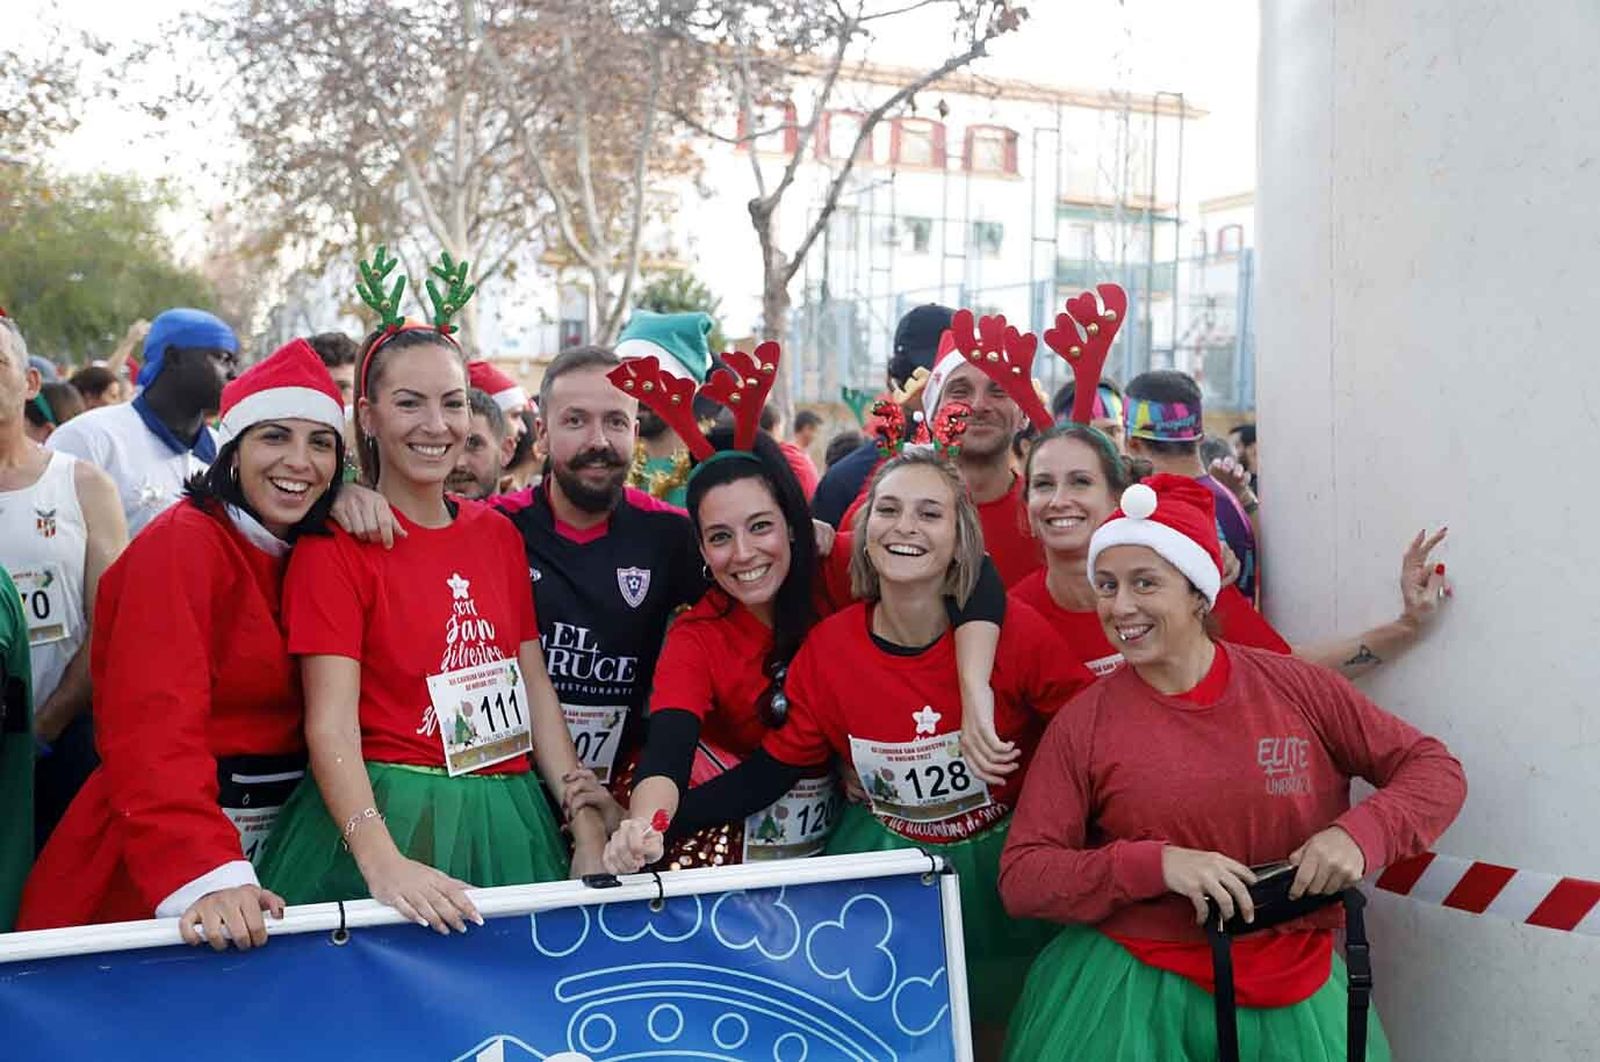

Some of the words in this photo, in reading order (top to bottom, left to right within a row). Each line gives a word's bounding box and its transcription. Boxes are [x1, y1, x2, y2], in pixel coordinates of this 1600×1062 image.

[549, 621, 600, 653] EL
[541, 640, 638, 684] RUCE
[480, 689, 522, 733] 111
[1257, 736, 1310, 769] ELITE
[904, 761, 971, 799] 128
